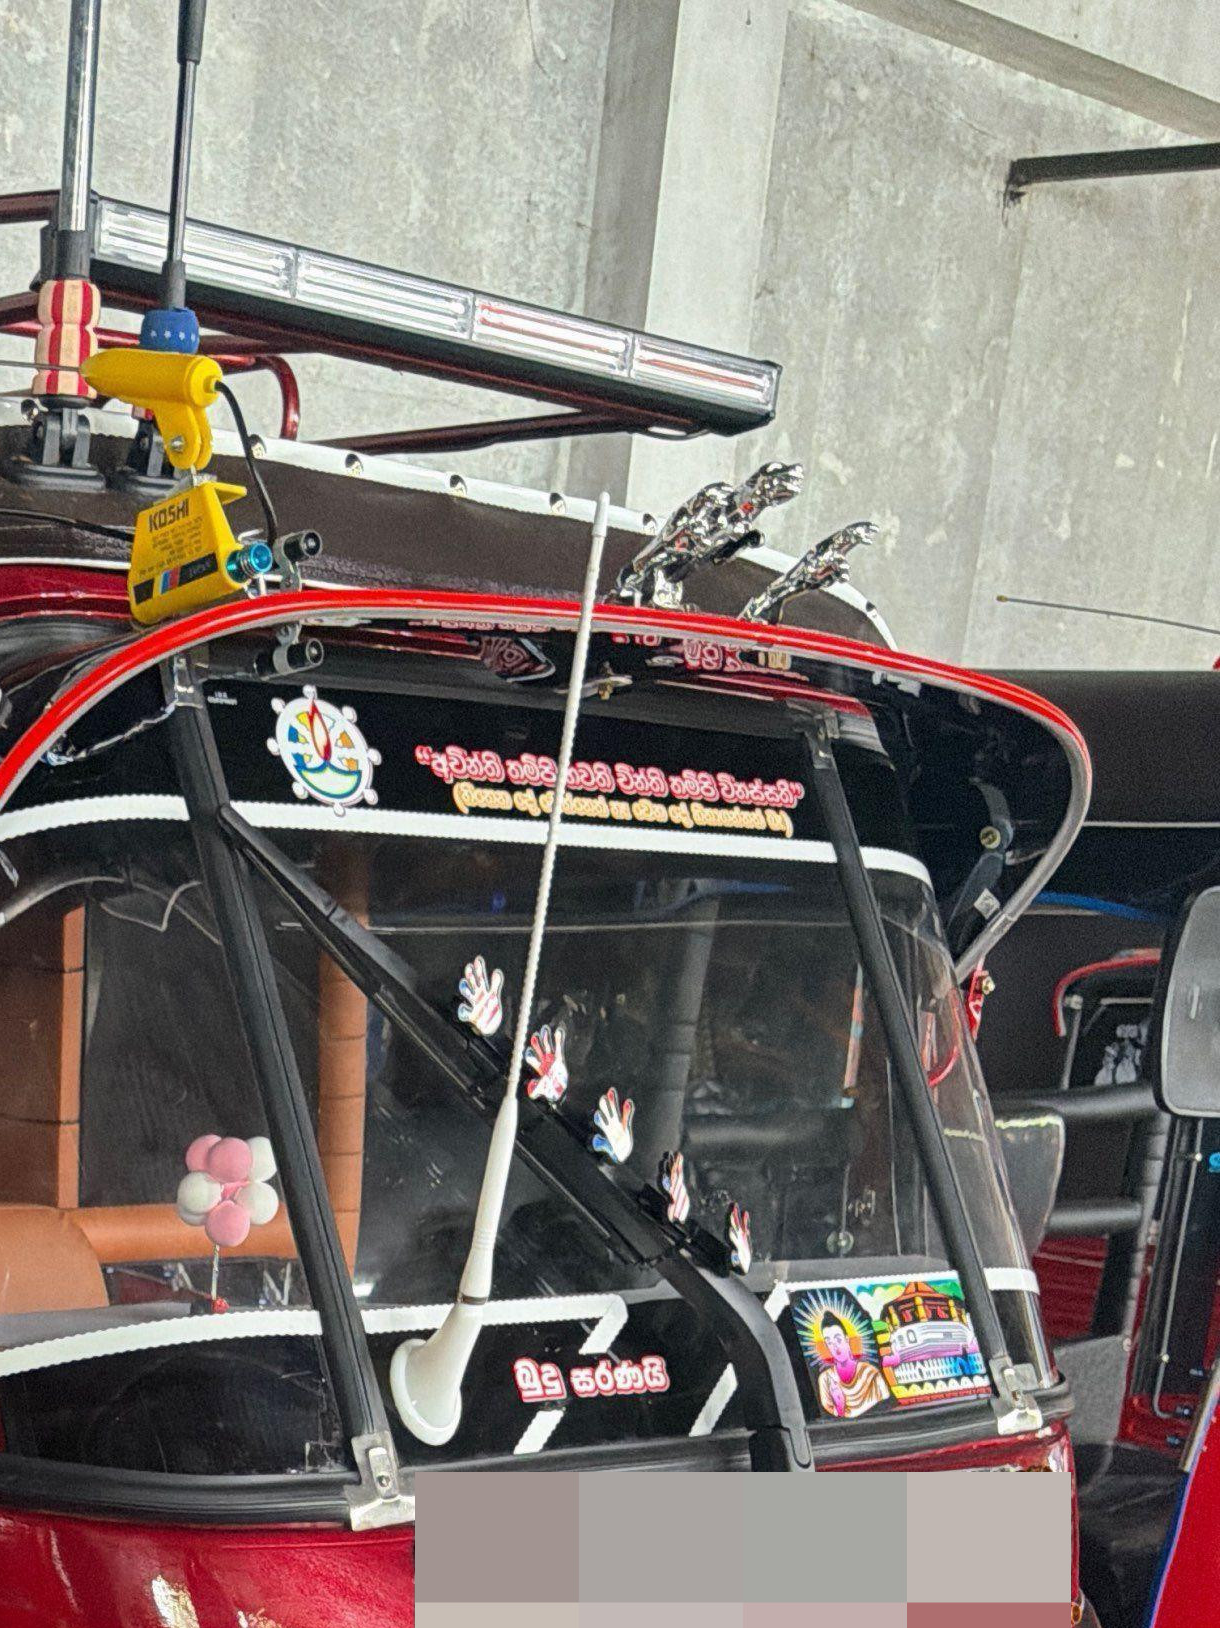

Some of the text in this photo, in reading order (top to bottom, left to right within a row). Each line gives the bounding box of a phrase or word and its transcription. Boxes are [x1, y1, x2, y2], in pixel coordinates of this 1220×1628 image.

[148, 498, 190, 532] KOSHI
[513, 1355, 671, 1403] බුදු සරණයි
